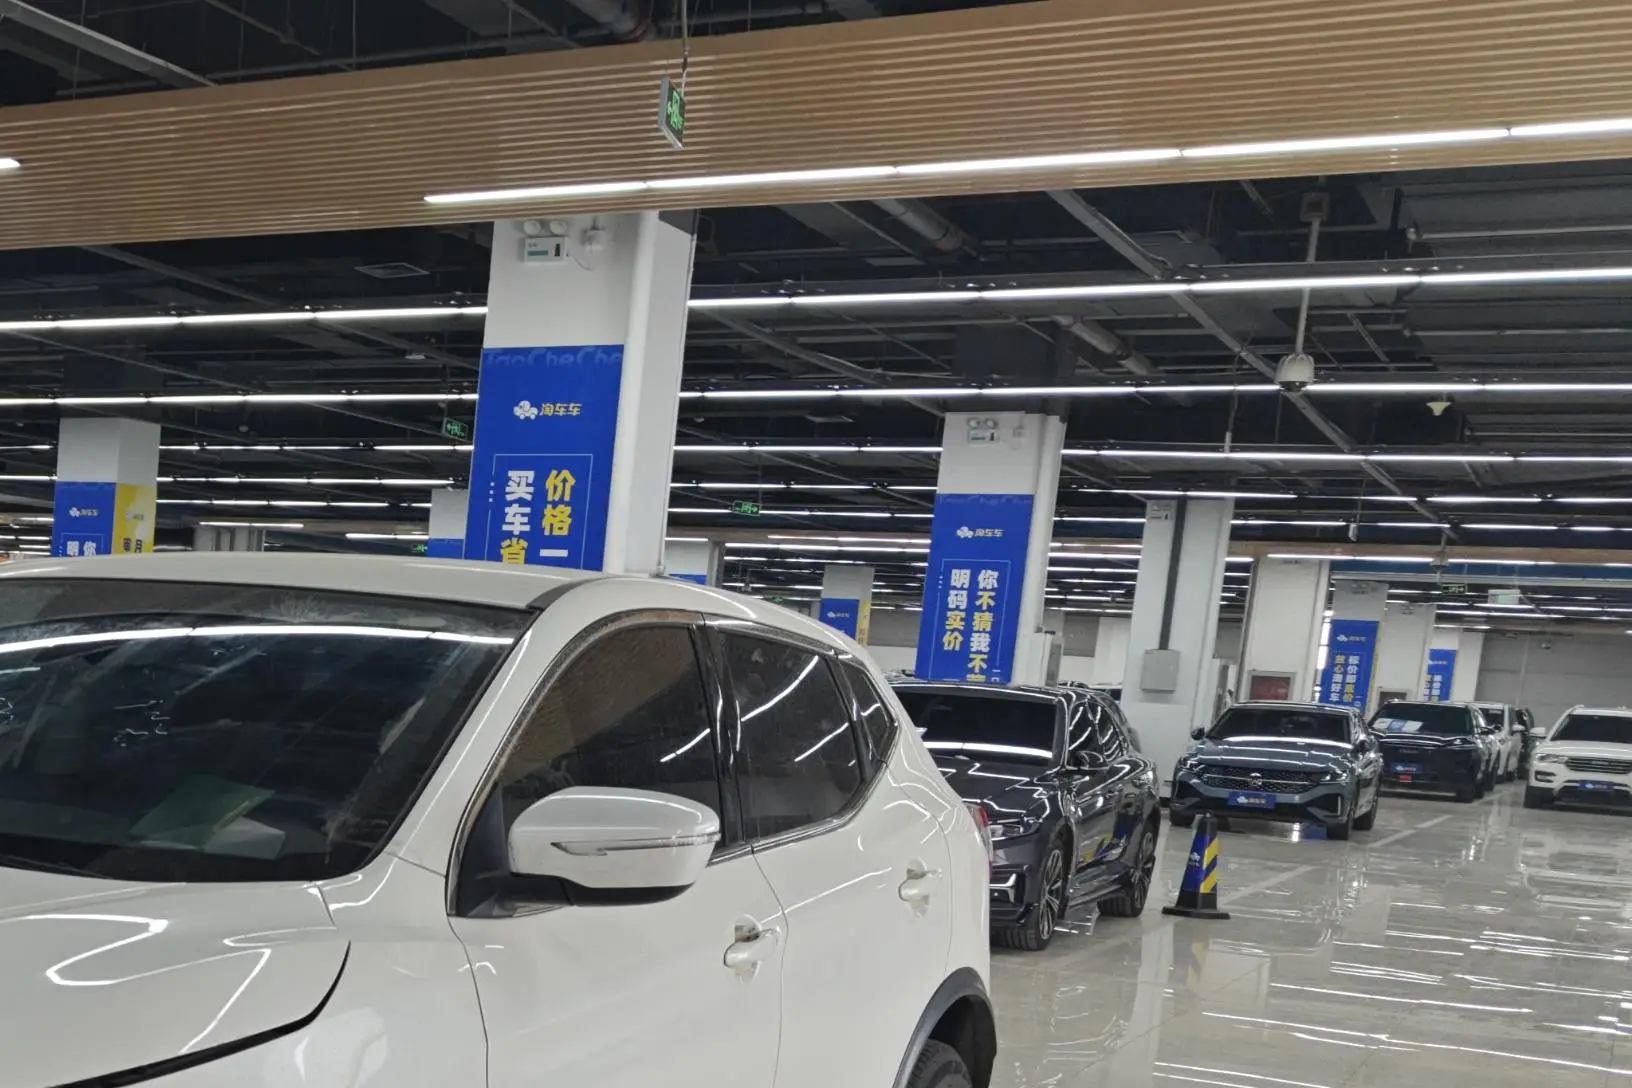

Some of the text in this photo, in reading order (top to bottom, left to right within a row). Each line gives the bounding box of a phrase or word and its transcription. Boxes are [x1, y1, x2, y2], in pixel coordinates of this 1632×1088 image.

[539, 403, 582, 417] 淘车车
[540, 469, 576, 557] 价格一
[943, 569, 971, 651] 明码实价
